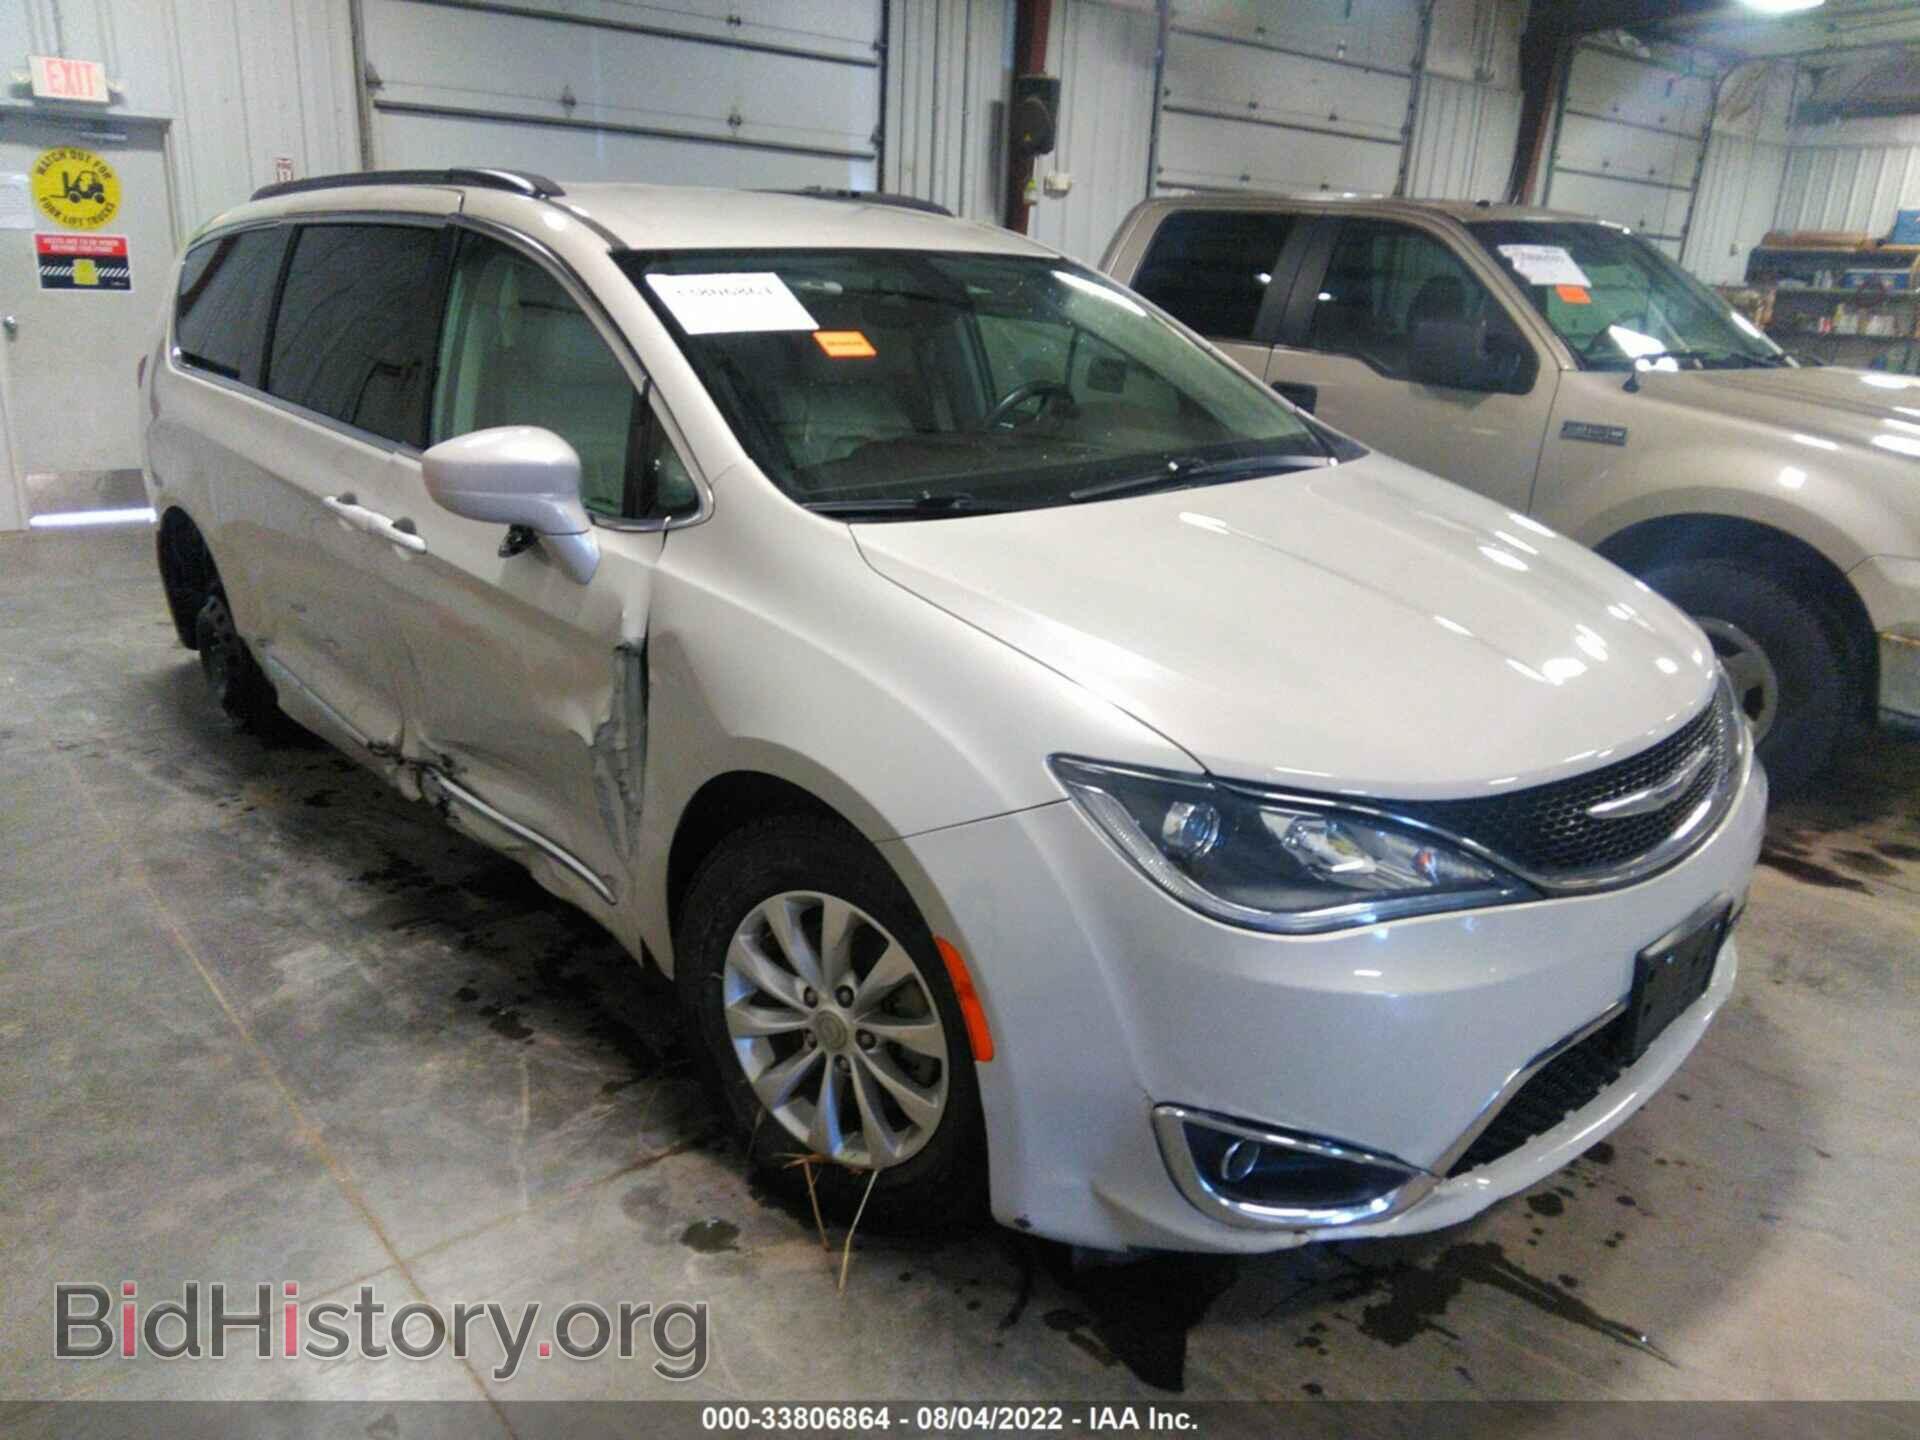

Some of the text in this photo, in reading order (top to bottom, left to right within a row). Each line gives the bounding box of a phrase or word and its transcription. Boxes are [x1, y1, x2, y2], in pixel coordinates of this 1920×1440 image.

[44, 59, 96, 97] EXIT
[37, 149, 112, 179] WATCH OUT FOR
